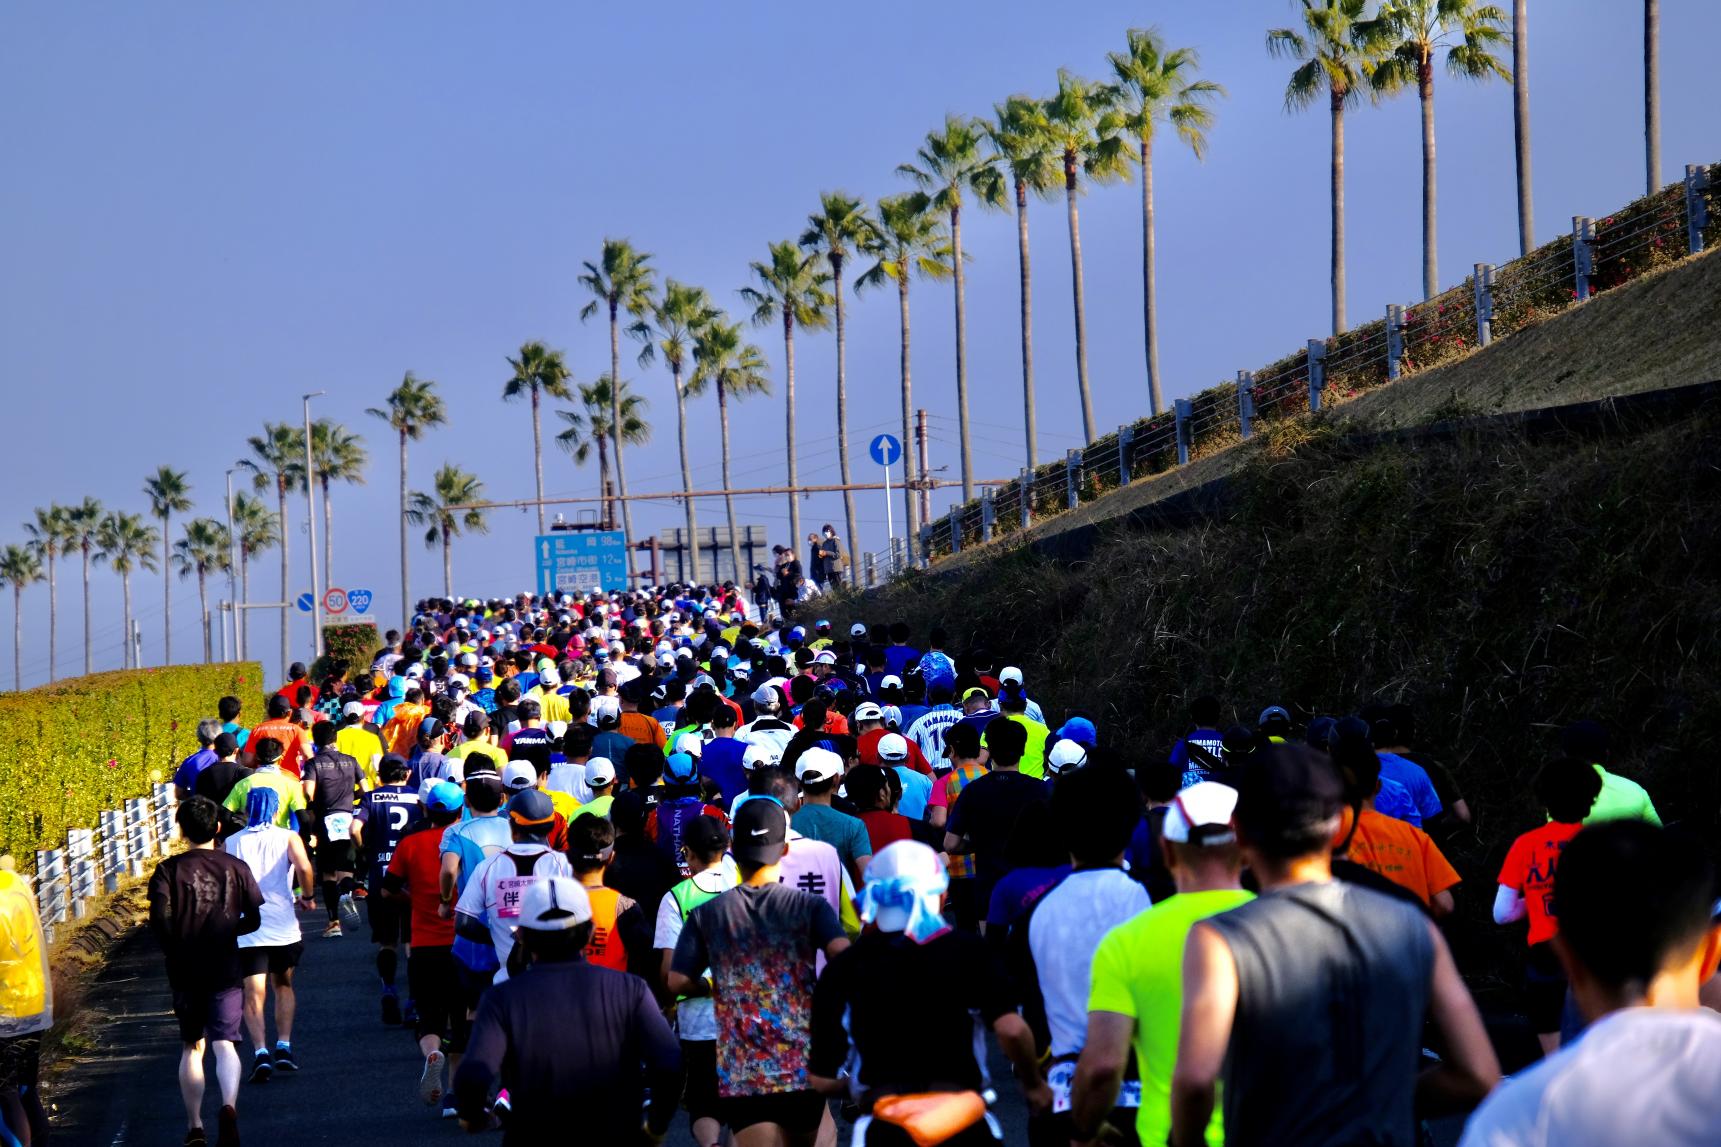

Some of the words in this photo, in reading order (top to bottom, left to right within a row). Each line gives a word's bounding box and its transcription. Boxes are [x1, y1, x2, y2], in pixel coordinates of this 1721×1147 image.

[328, 594, 344, 607] 50
[351, 595, 369, 606] 220
[923, 715, 960, 728] YAMASAK
[513, 737, 547, 745] YANMA
